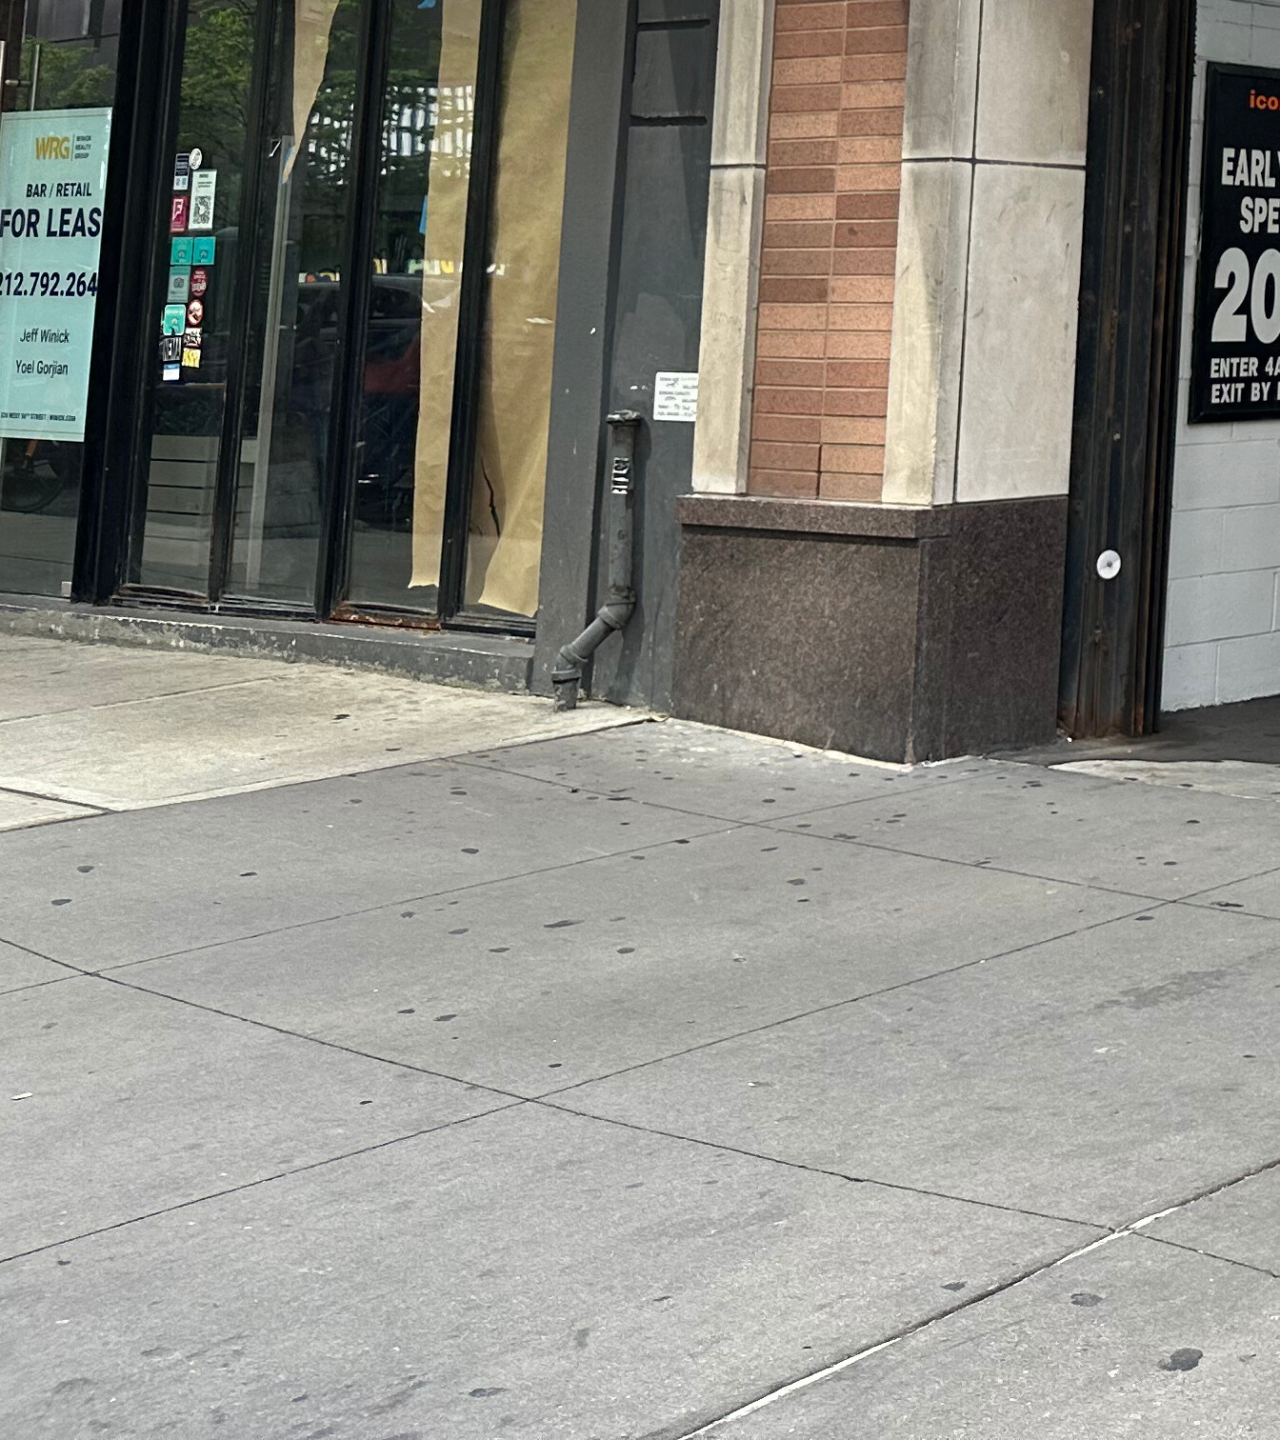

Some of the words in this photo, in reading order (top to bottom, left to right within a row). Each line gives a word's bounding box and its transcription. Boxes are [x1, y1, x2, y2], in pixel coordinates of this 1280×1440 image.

[36, 136, 69, 160] WRG
[26, 183, 47, 197] BAR
[56, 182, 92, 197] RETAIL
[0, 208, 40, 238] FOR
[20, 328, 39, 342] Jeff
[41, 328, 70, 343] Winick
[16, 360, 35, 374] Yoel
[37, 360, 68, 378] Gorjian
[1210, 357, 1258, 379] ENTER
[1210, 383, 1245, 404] EXIT
[1251, 382, 1270, 401] BY
